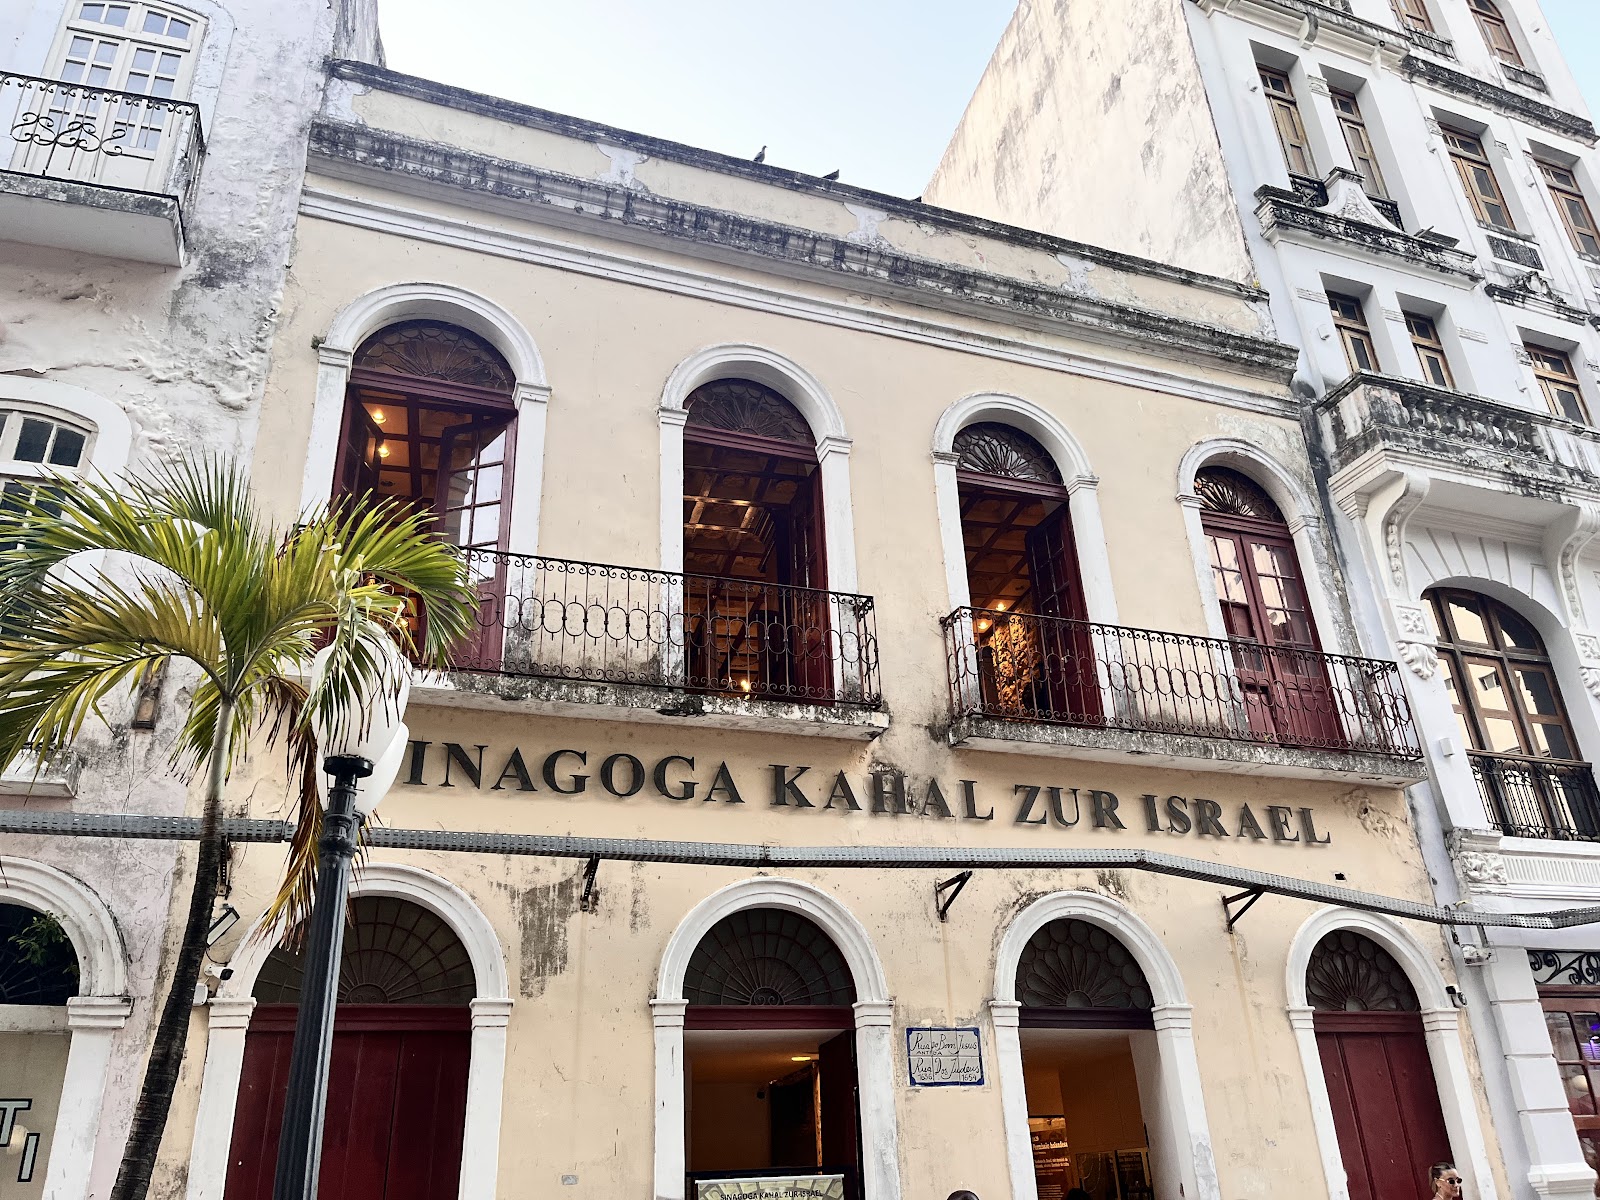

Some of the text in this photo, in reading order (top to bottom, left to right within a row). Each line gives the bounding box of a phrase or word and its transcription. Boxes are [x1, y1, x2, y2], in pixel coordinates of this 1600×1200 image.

[403, 739, 1333, 846] INAGOGA KAHAL ZUR ISRAEL
[910, 1032, 931, 1052] Rua
[912, 1057, 932, 1075] Rua
